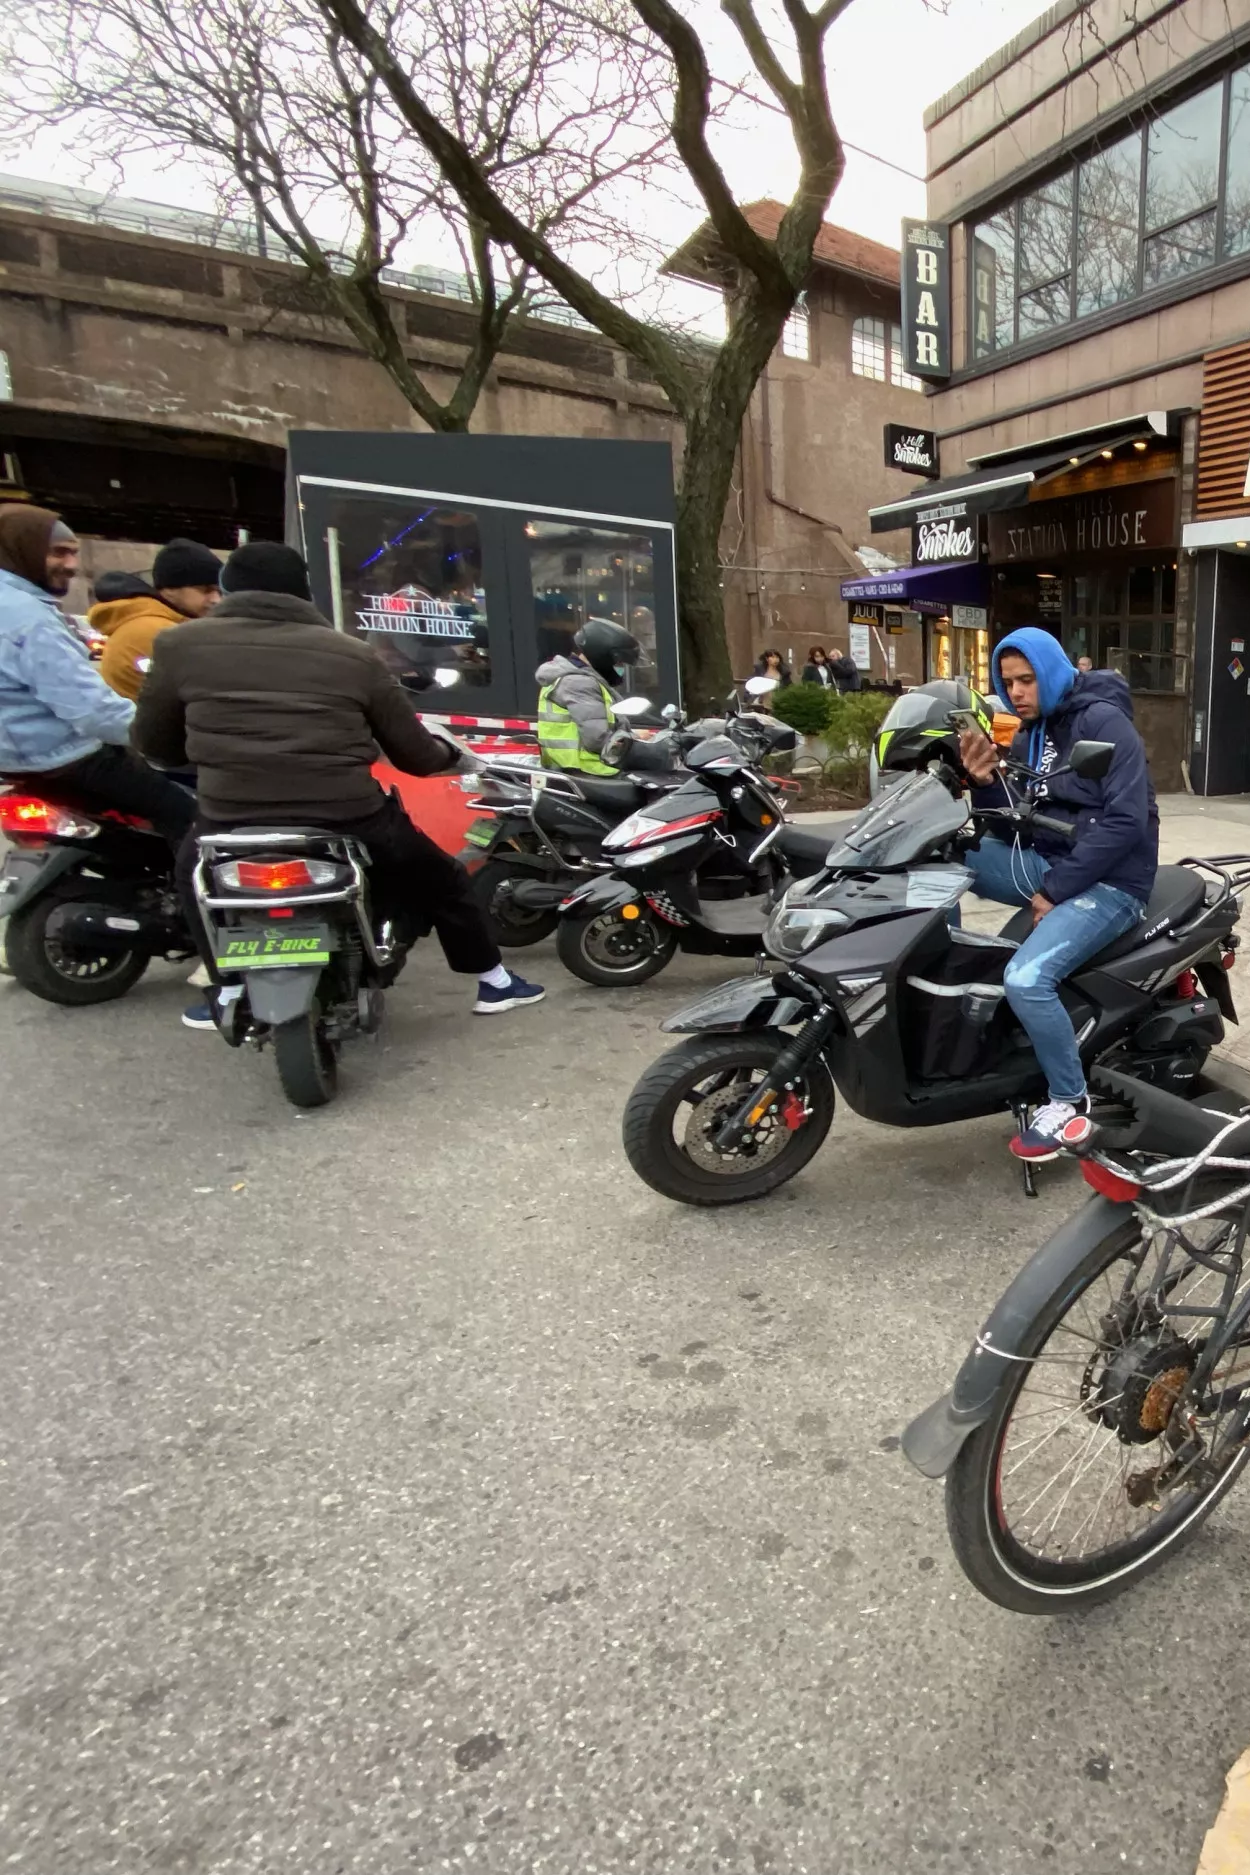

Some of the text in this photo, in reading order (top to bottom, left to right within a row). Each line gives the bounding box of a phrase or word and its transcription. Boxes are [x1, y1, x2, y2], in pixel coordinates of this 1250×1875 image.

[915, 249, 939, 367] BAR
[894, 442, 932, 467] Smokes
[916, 519, 975, 560] Smokes
[1007, 521, 1067, 558] STATION
[1077, 510, 1147, 550] HOUSE
[359, 613, 473, 638] STATION HOUSE
[957, 607, 982, 619] CBD
[226, 938, 321, 955] FLY E-BIKE
